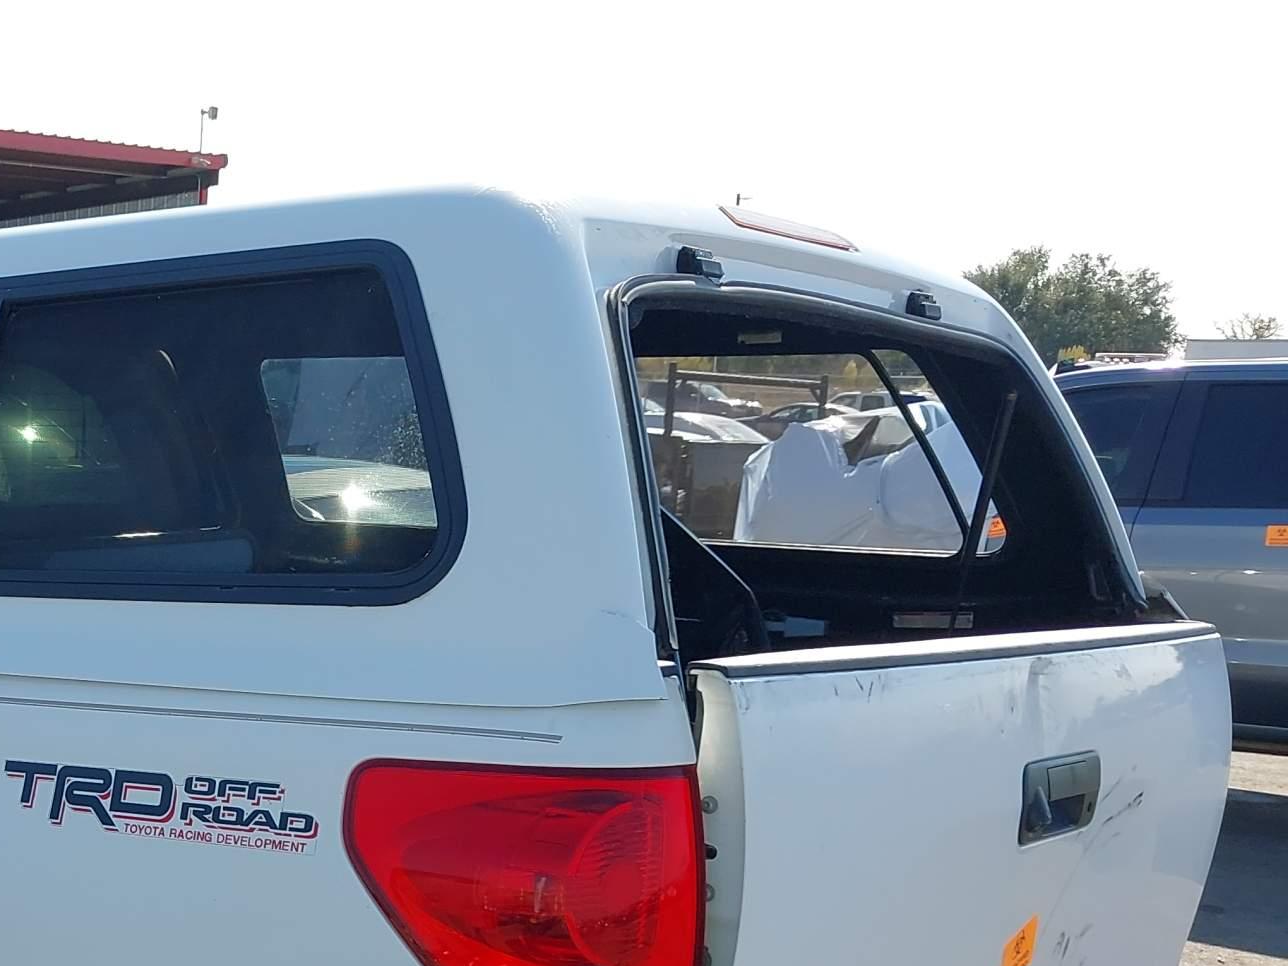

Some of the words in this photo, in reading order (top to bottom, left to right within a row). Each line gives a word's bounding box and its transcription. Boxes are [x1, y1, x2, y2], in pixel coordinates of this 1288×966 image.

[5, 760, 176, 832] TRD
[184, 776, 285, 805] OFF
[179, 802, 318, 839] ROAD
[123, 823, 166, 838] TOYOTA
[169, 829, 213, 844] RACING
[216, 833, 308, 854] DEVELOPMENT
